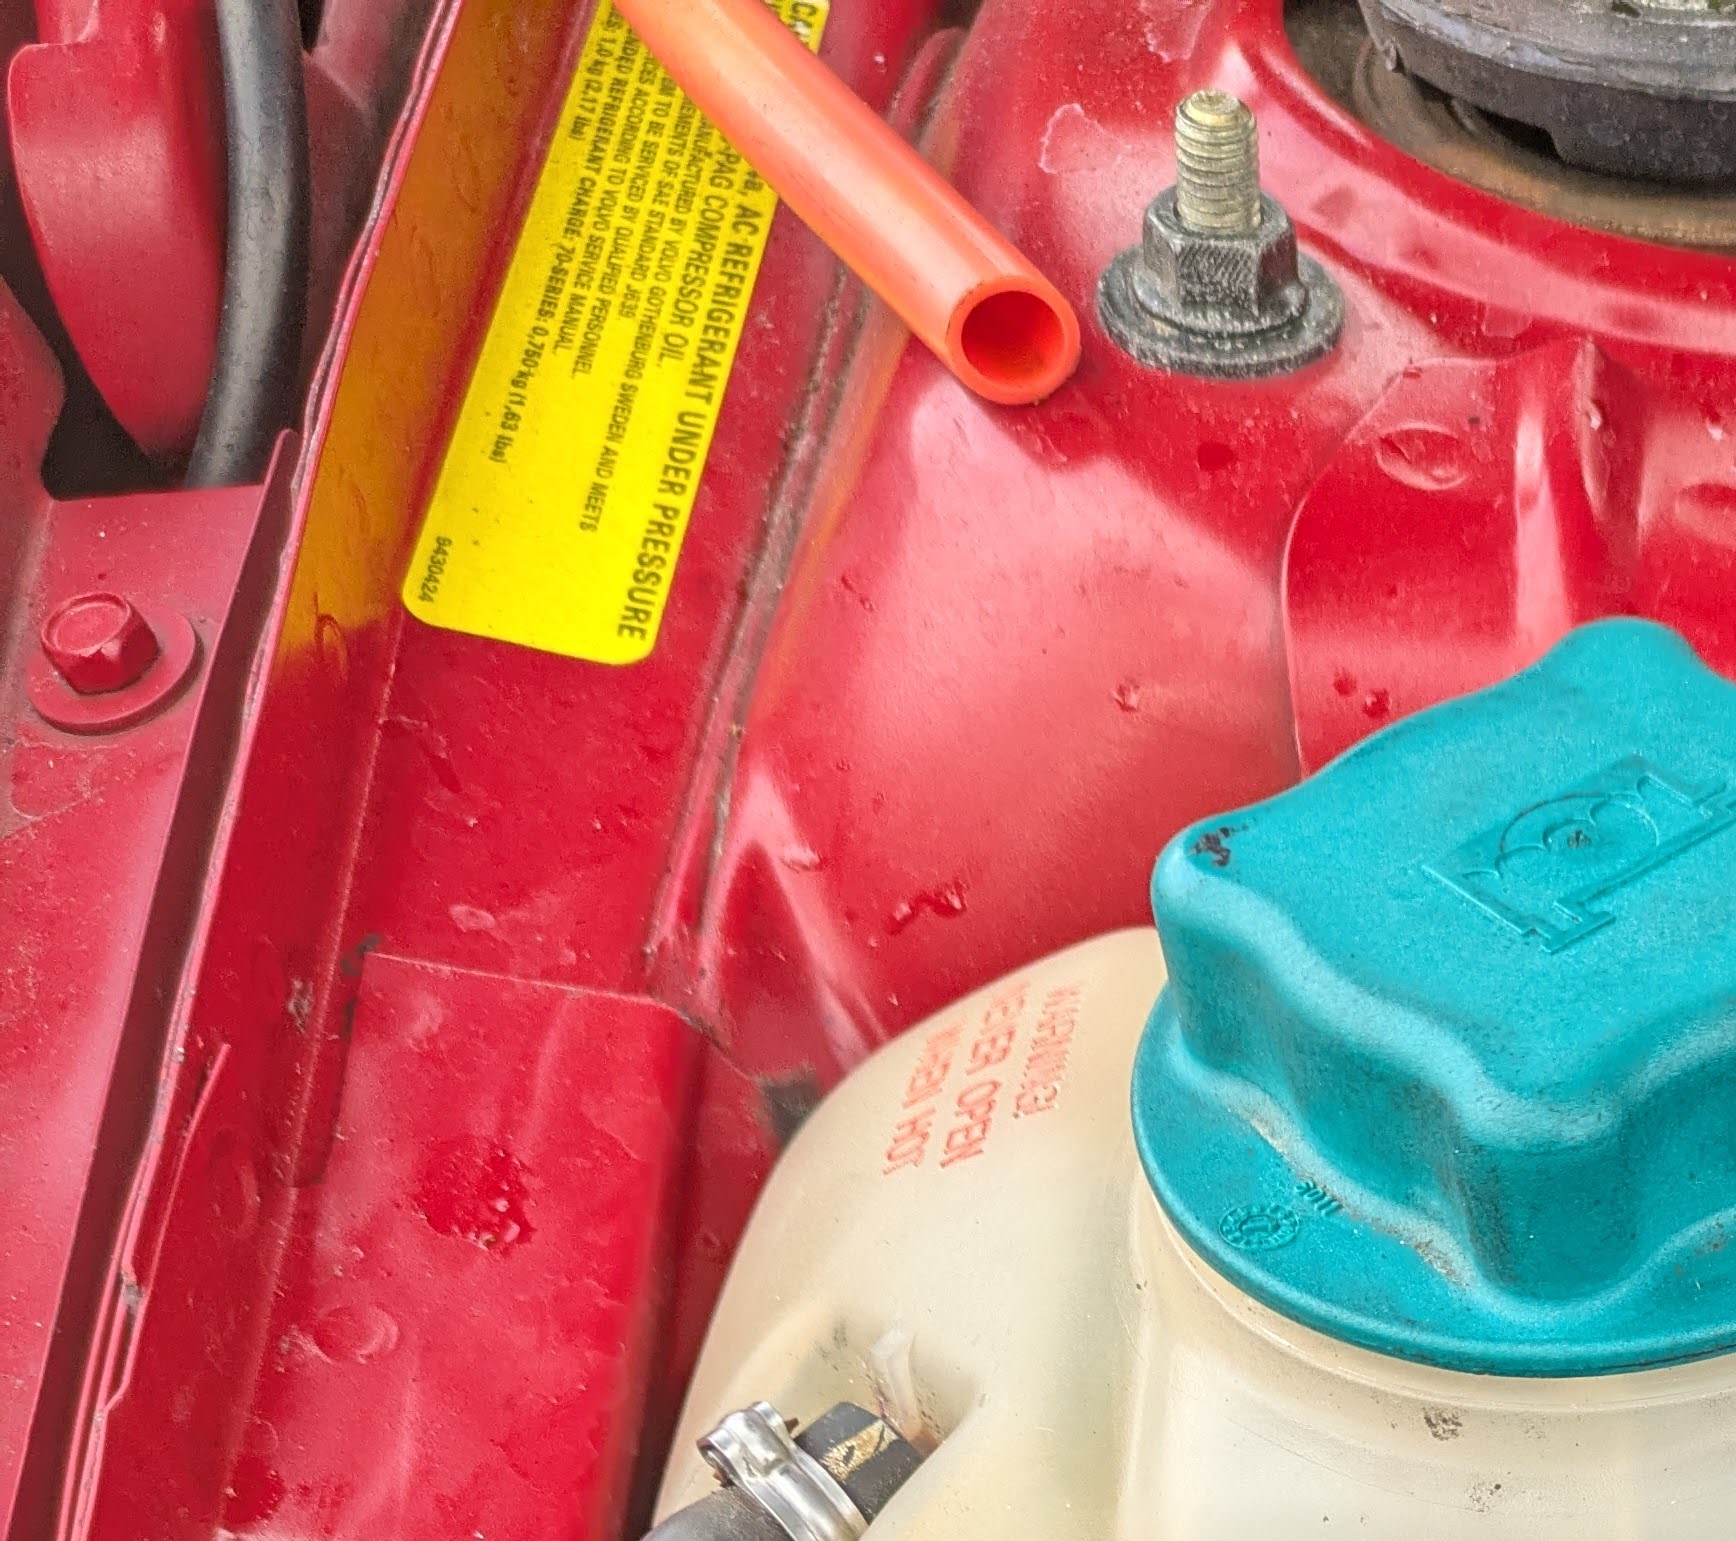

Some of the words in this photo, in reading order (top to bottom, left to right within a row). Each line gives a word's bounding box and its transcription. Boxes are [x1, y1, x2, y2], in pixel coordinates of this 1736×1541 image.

[583, 75, 629, 176] REFRIGERANT
[612, 86, 651, 166] ACCORDING
[645, 119, 665, 138] BE
[651, 98, 672, 119] TO
[606, 165, 627, 187] TO
[625, 138, 659, 204] SERVICED
[651, 178, 675, 208] SAE
[661, 160, 680, 178] OF
[591, 187, 620, 233] VOLVO
[619, 204, 640, 223] BY
[667, 216, 687, 236] BY
[729, 203, 764, 238] AC
[573, 233, 605, 292] SERVICE
[597, 224, 634, 297] QUALIFIED
[629, 208, 666, 283] STANDARD
[652, 235, 682, 284] VOLVO
[668, 191, 729, 330] COMPRESSOR
[623, 284, 667, 381] GOTHENBURG
[683, 239, 754, 405] REFRIGERANT
[604, 381, 639, 444] SWEDEN
[594, 445, 619, 480] AND
[656, 406, 708, 499] UNDER
[578, 480, 609, 534] MEETS
[615, 501, 681, 643] PRESSURE
[938, 1075, 1004, 1169] OPEN
